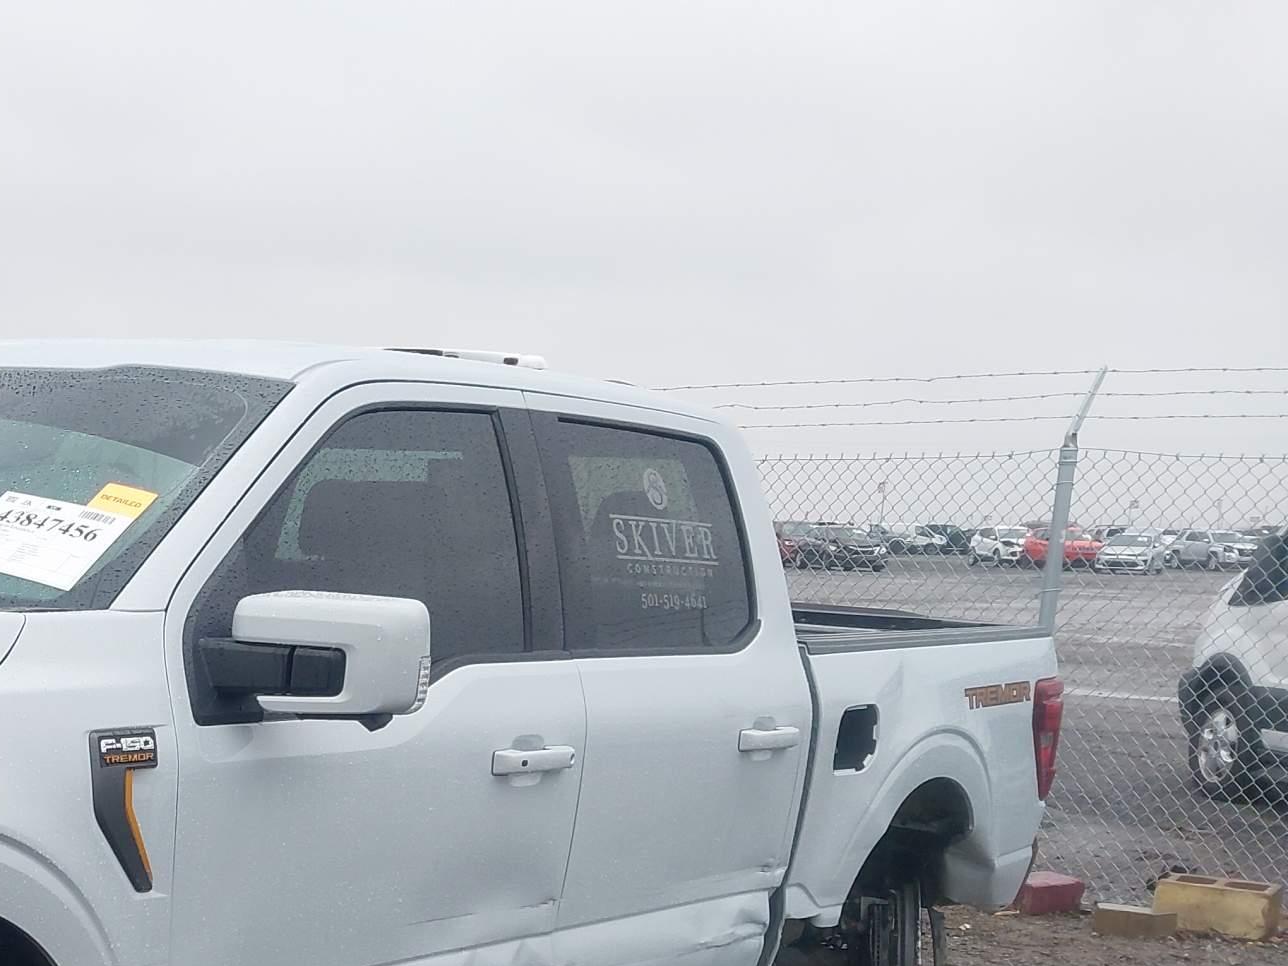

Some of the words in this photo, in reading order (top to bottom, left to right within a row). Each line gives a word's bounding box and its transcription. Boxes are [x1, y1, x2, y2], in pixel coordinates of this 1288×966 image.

[612, 517, 718, 561] SKIVER
[626, 562, 713, 577] CONSTRUCTION
[964, 681, 1031, 710] TREMOR
[100, 736, 155, 753] F-150
[103, 752, 154, 764] TREMOR
